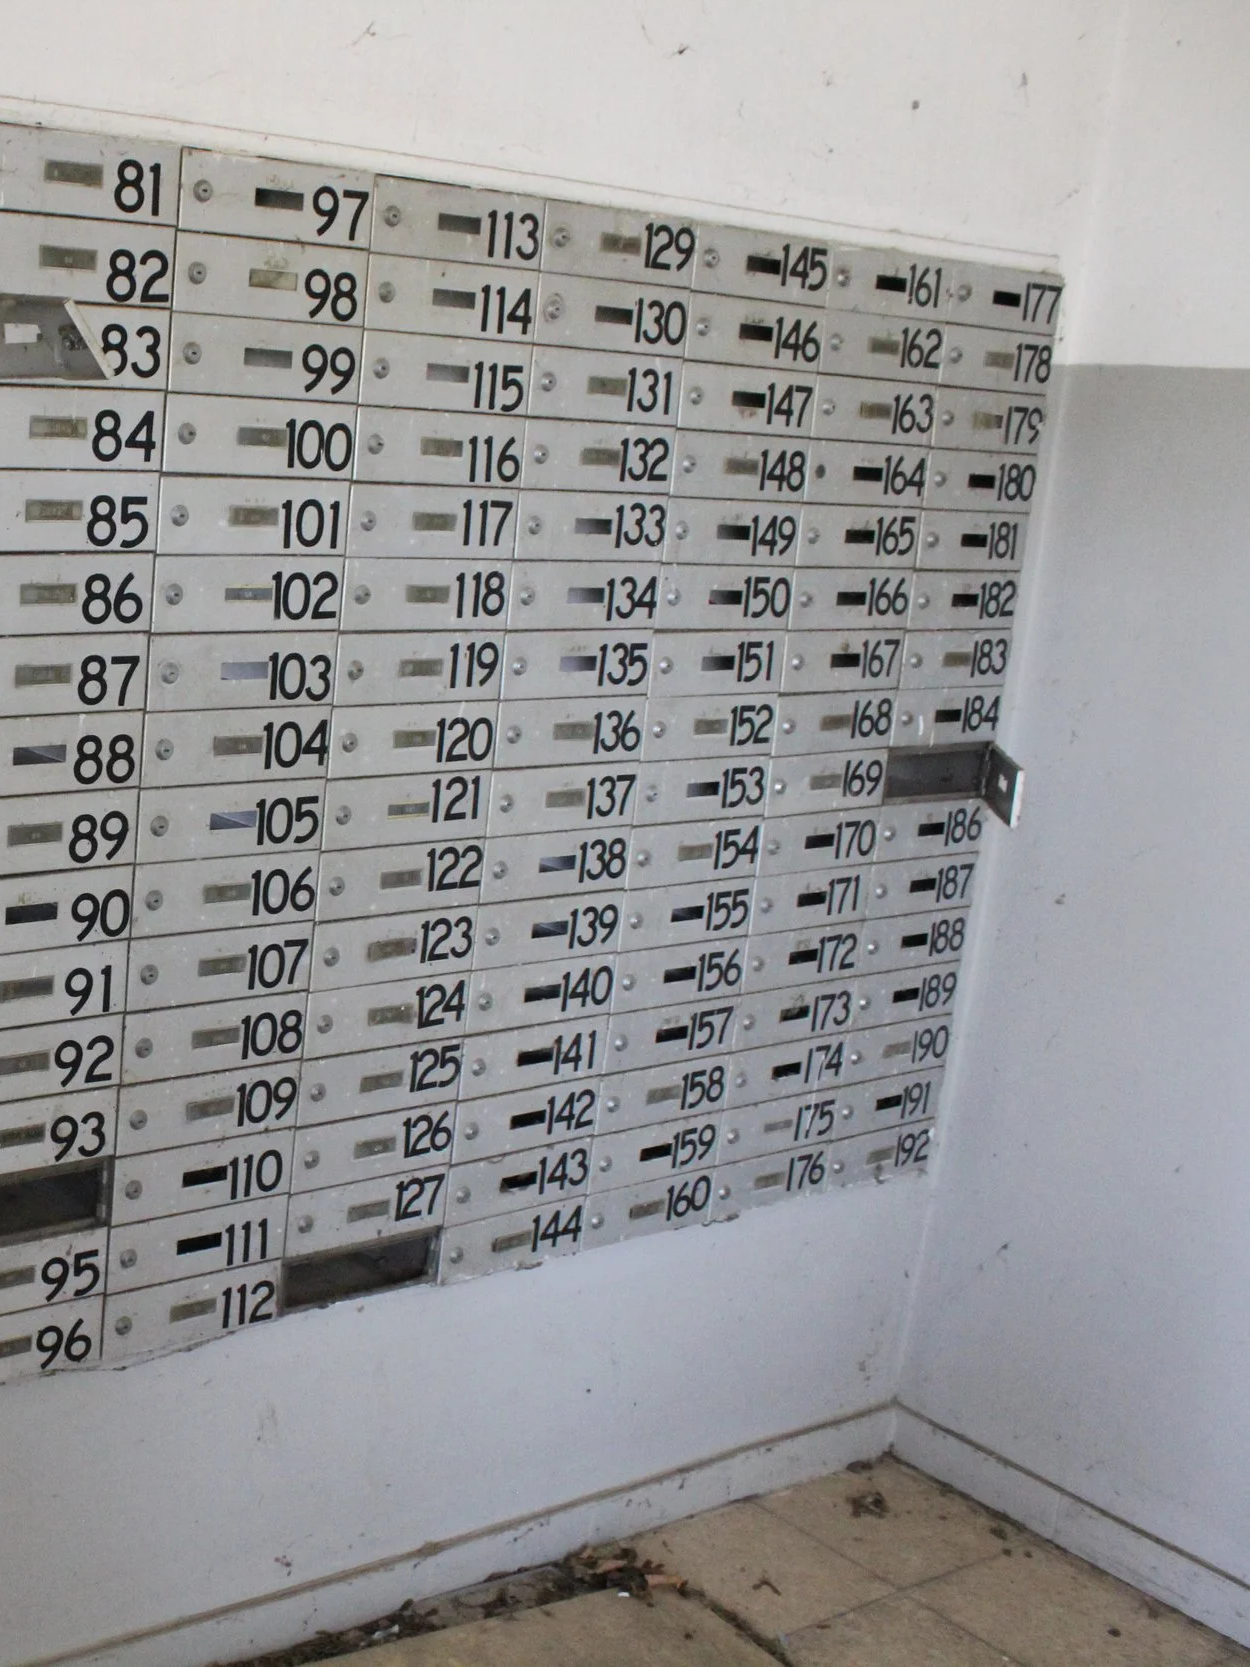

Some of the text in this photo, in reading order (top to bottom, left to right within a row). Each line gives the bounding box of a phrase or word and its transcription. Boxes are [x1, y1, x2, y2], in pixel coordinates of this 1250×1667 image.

[114, 159, 161, 216] 81
[313, 186, 369, 241] 97
[488, 210, 539, 260] 113
[645, 223, 695, 271] 129
[106, 248, 170, 303] 82
[305, 269, 357, 322] 98
[908, 264, 941, 308] 161
[481, 285, 532, 335] 114
[635, 298, 687, 345] 130
[1022, 282, 1063, 324] 177
[775, 317, 820, 362] 146
[900, 327, 942, 369] 162
[302, 343, 356, 397] 99
[474, 361, 523, 412] 115
[1014, 343, 1052, 384] 178
[627, 367, 672, 415] 131
[767, 383, 813, 427] 147
[892, 394, 933, 434] 163
[92, 410, 156, 462] 84
[286, 419, 352, 471] 100
[469, 436, 520, 482] 116
[620, 438, 669, 482] 132
[760, 449, 805, 492] 148
[884, 456, 925, 496] 164
[997, 464, 1036, 501] 180
[87, 495, 148, 548] 85
[282, 499, 340, 549] 101
[463, 500, 513, 546] 117
[615, 503, 666, 548] 133
[752, 515, 796, 556] 149
[876, 516, 915, 555] 165
[988, 521, 1018, 560] 181
[82, 572, 143, 624] 86
[272, 571, 338, 620] 102
[456, 571, 504, 618] 118
[606, 576, 657, 621] 134
[743, 576, 791, 618] 150
[868, 578, 908, 616] 166
[979, 580, 1016, 619] 182
[593, 710, 640, 754] 136
[730, 704, 773, 746] 152
[851, 699, 892, 739] 168
[962, 695, 1000, 733] 184
[74, 734, 135, 784] 88
[264, 719, 331, 769] 104
[437, 717, 493, 763] 120
[432, 776, 480, 823] 121
[587, 774, 636, 819] 137
[722, 766, 764, 808] 153
[843, 760, 883, 797] 169
[69, 810, 128, 863] 89
[256, 796, 319, 845] 105
[835, 820, 875, 859] 170
[945, 806, 981, 846] 186
[427, 845, 483, 892] 122
[579, 838, 626, 883] 138
[714, 826, 759, 870] 154
[252, 866, 315, 916] 106
[827, 875, 860, 915] 171
[936, 863, 974, 903] 187
[71, 888, 130, 942] 90
[569, 904, 618, 949] 139
[706, 888, 749, 931] 155
[420, 916, 472, 963] 123
[817, 933, 857, 973] 172
[929, 917, 965, 956] 188
[248, 939, 308, 990] 107
[698, 949, 741, 992] 156
[65, 965, 111, 1016] 91
[416, 980, 465, 1029] 124
[561, 966, 613, 1012] 140
[811, 990, 851, 1032] 173
[919, 972, 957, 1011] 189
[241, 1010, 303, 1060] 108
[689, 1006, 734, 1050] 157
[912, 1025, 949, 1064] 190
[55, 1035, 114, 1087] 92
[410, 1044, 462, 1092] 125
[554, 1030, 596, 1075] 141
[237, 1077, 297, 1127] 109
[681, 1066, 724, 1110] 158
[900, 1081, 932, 1120] 191
[403, 1111, 453, 1158] 126
[547, 1089, 595, 1135] 142
[50, 1112, 105, 1162] 93
[672, 1124, 715, 1168] 159
[894, 1129, 930, 1167] 192
[229, 1150, 282, 1200] 110
[539, 1148, 588, 1195] 143
[786, 1151, 825, 1191] 176
[395, 1173, 445, 1221] 127
[666, 1175, 711, 1221] 160
[532, 1205, 582, 1252] 144
[41, 1250, 99, 1303] 95
[222, 1279, 275, 1328] 112
[36, 1317, 92, 1371] 96
